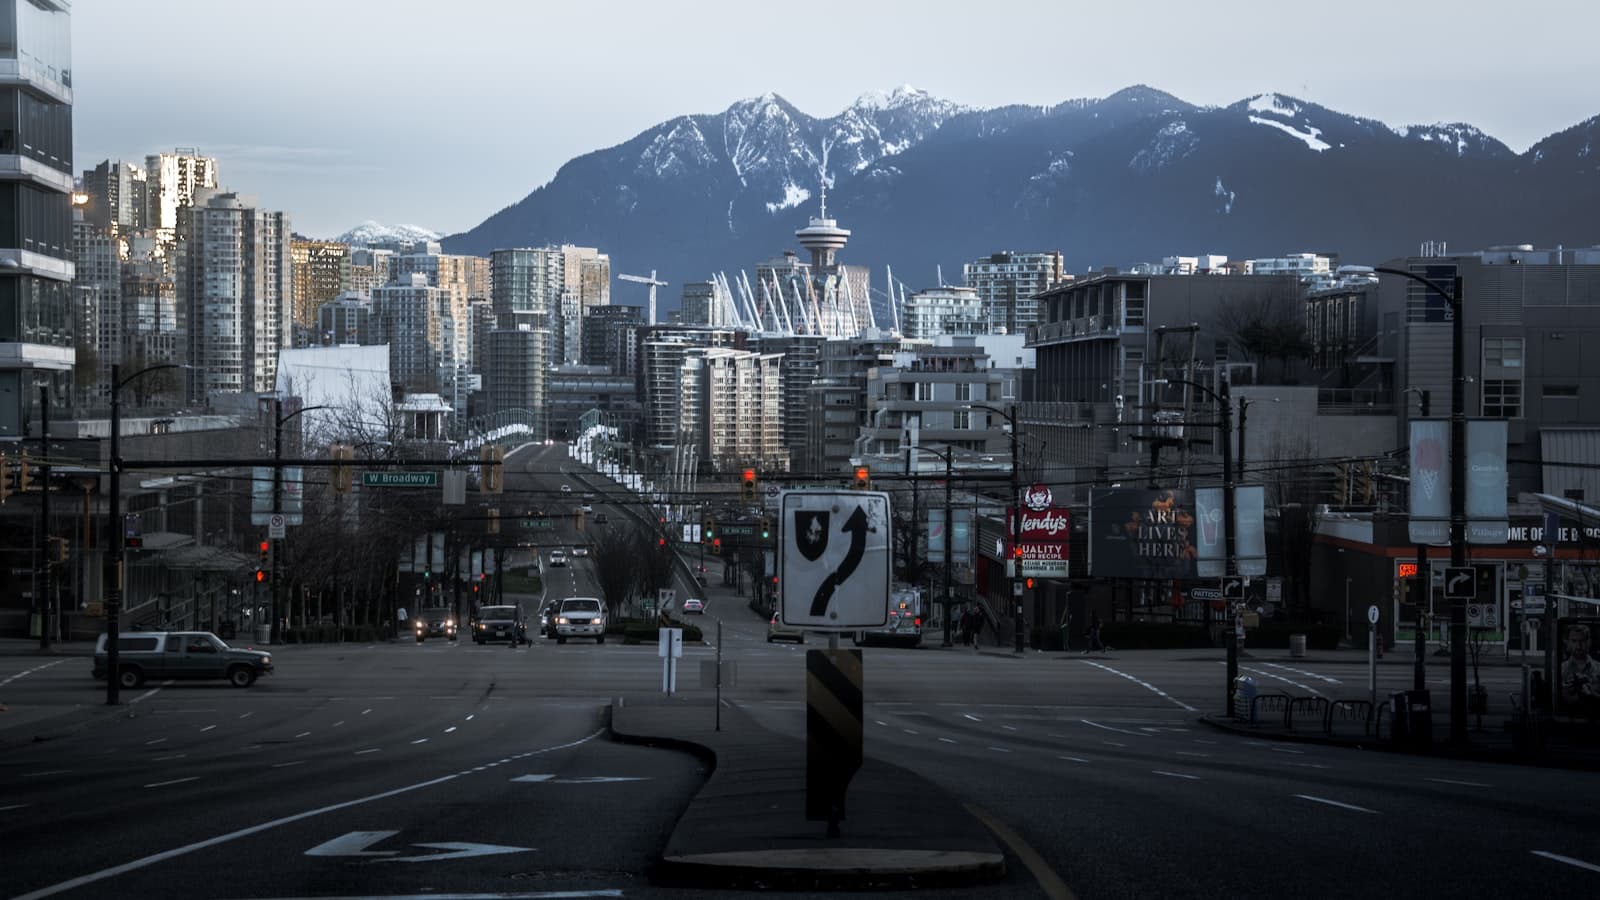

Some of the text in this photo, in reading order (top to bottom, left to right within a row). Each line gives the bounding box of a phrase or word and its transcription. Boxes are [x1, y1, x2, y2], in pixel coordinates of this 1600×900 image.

[369, 473, 431, 486] W Broadway
[1147, 510, 1176, 524] ART
[1138, 526, 1189, 540] LIVES
[1531, 527, 1544, 541] OF
[1014, 545, 1062, 554] UALITY
[1139, 542, 1185, 558] HERE
[1194, 589, 1222, 599] PATTISO
